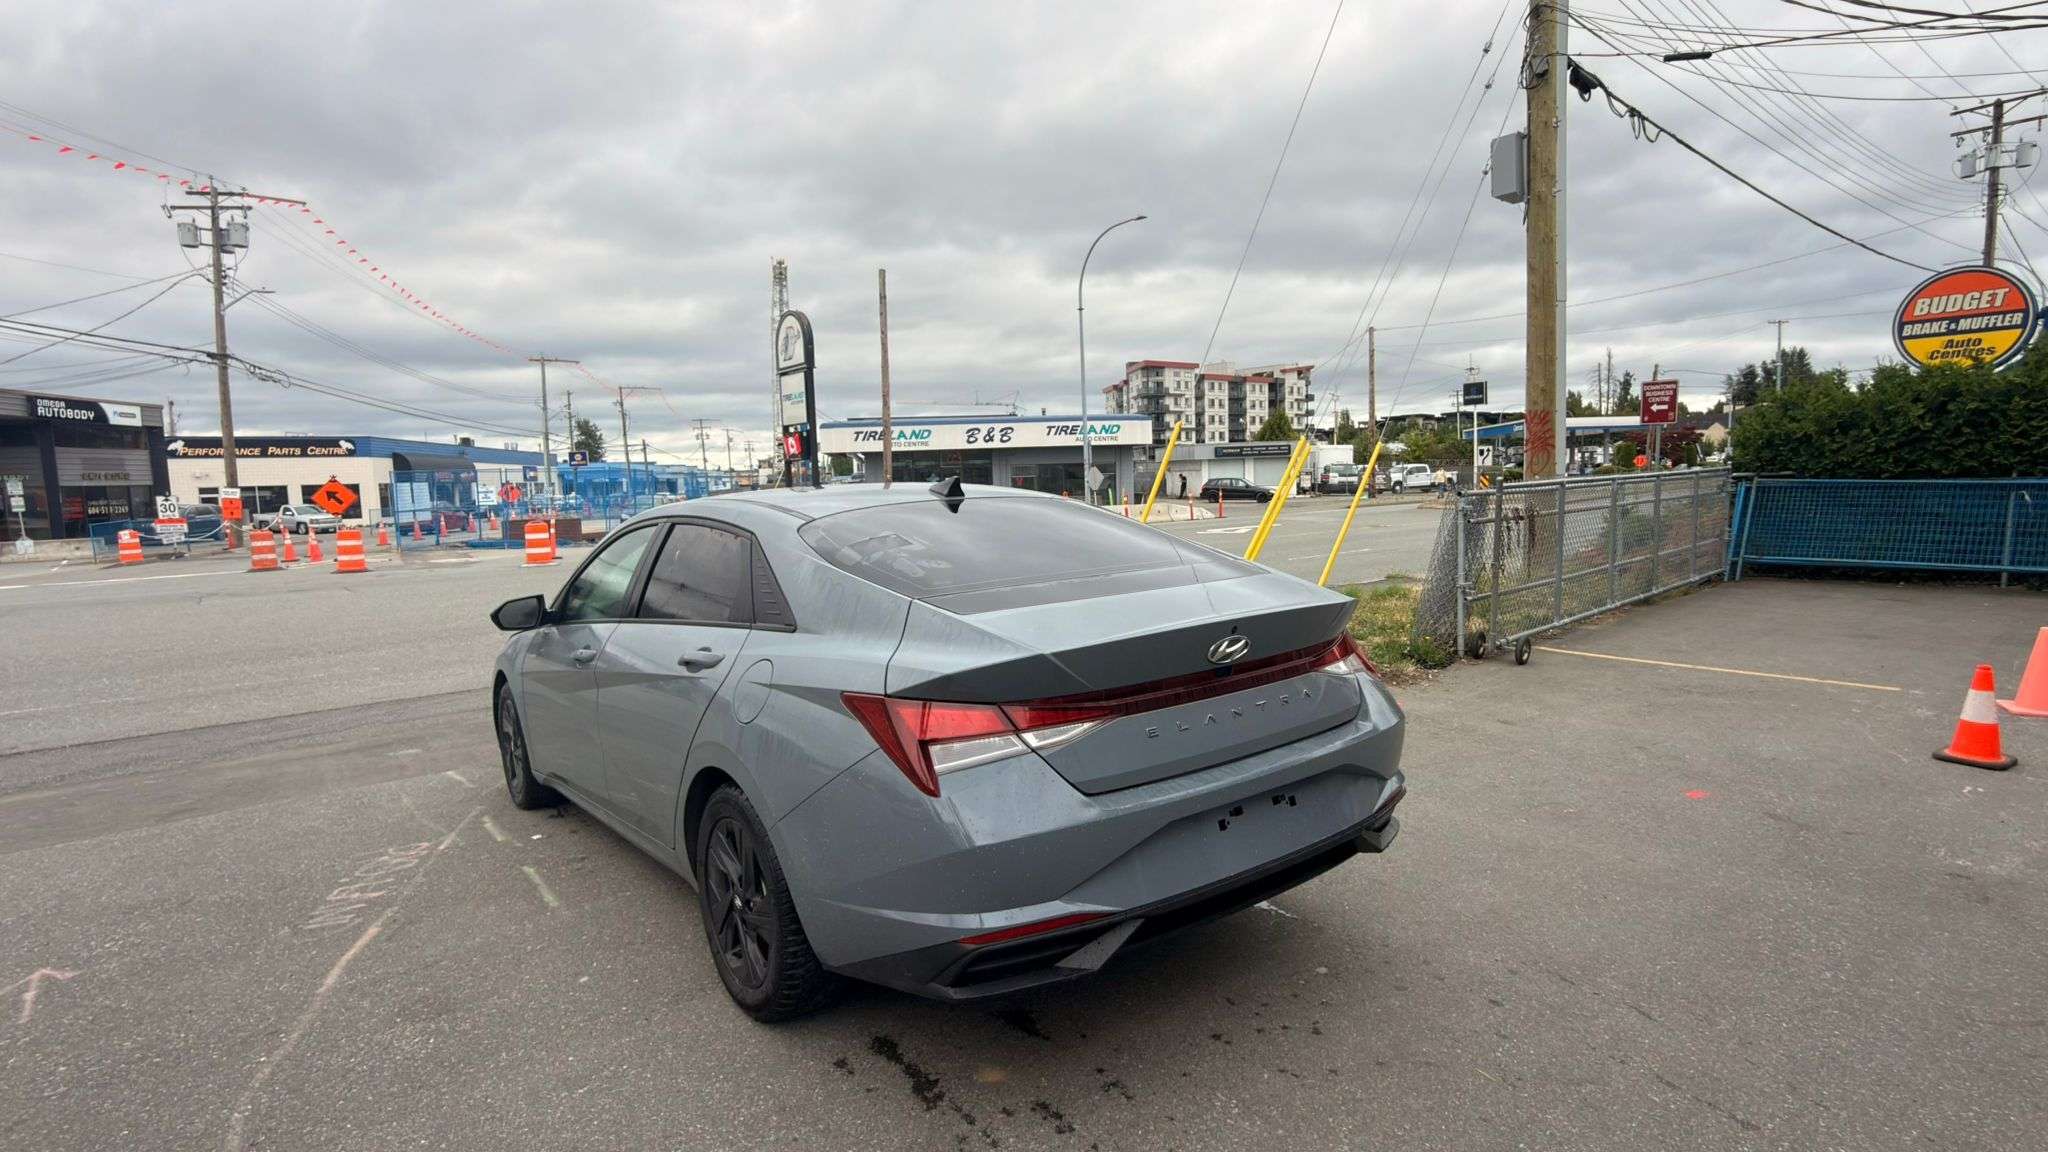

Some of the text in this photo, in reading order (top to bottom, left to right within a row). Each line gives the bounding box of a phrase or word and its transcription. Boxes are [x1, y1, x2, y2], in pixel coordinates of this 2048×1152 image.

[1914, 288, 2010, 317] BUDGET
[1902, 320, 1950, 337] BRAKE
[1957, 312, 2024, 331] MUFFLER
[1943, 337, 1983, 350] Auto
[1929, 346, 1997, 361] Centres
[36, 398, 65, 408] OMEGA
[37, 406, 95, 421] AUTOBODY
[179, 446, 346, 456] PERFORANCE PARTS CENTRE
[160, 503, 176, 513] 30
[1144, 689, 1313, 738] ELANTRA
